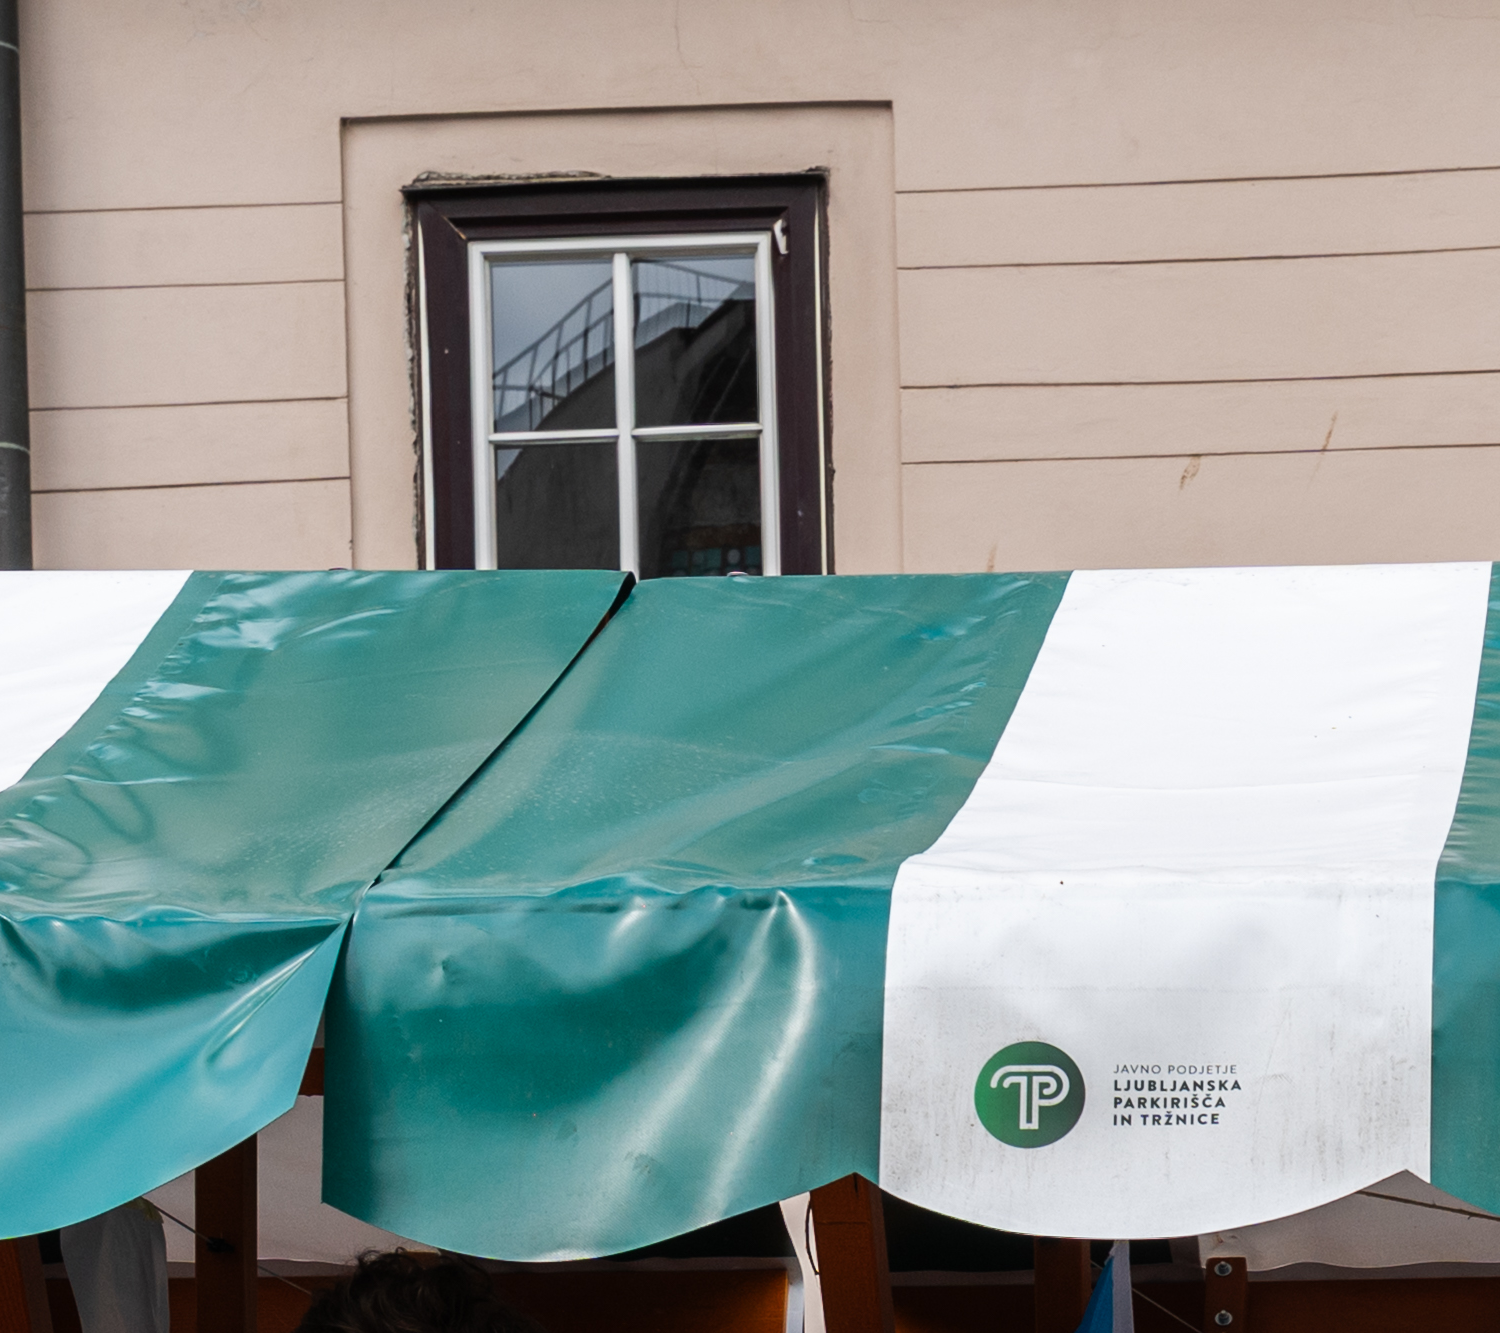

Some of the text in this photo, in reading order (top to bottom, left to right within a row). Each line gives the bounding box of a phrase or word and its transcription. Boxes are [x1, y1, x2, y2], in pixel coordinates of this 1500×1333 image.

[1113, 1064, 1237, 1075] JAVNO PODJETJE
[1113, 1079, 1242, 1092] LJUBLJANSKA
[1113, 1093, 1226, 1109] PARKIRIŠČA
[1113, 1111, 1220, 1126] IN TRŽNICE
